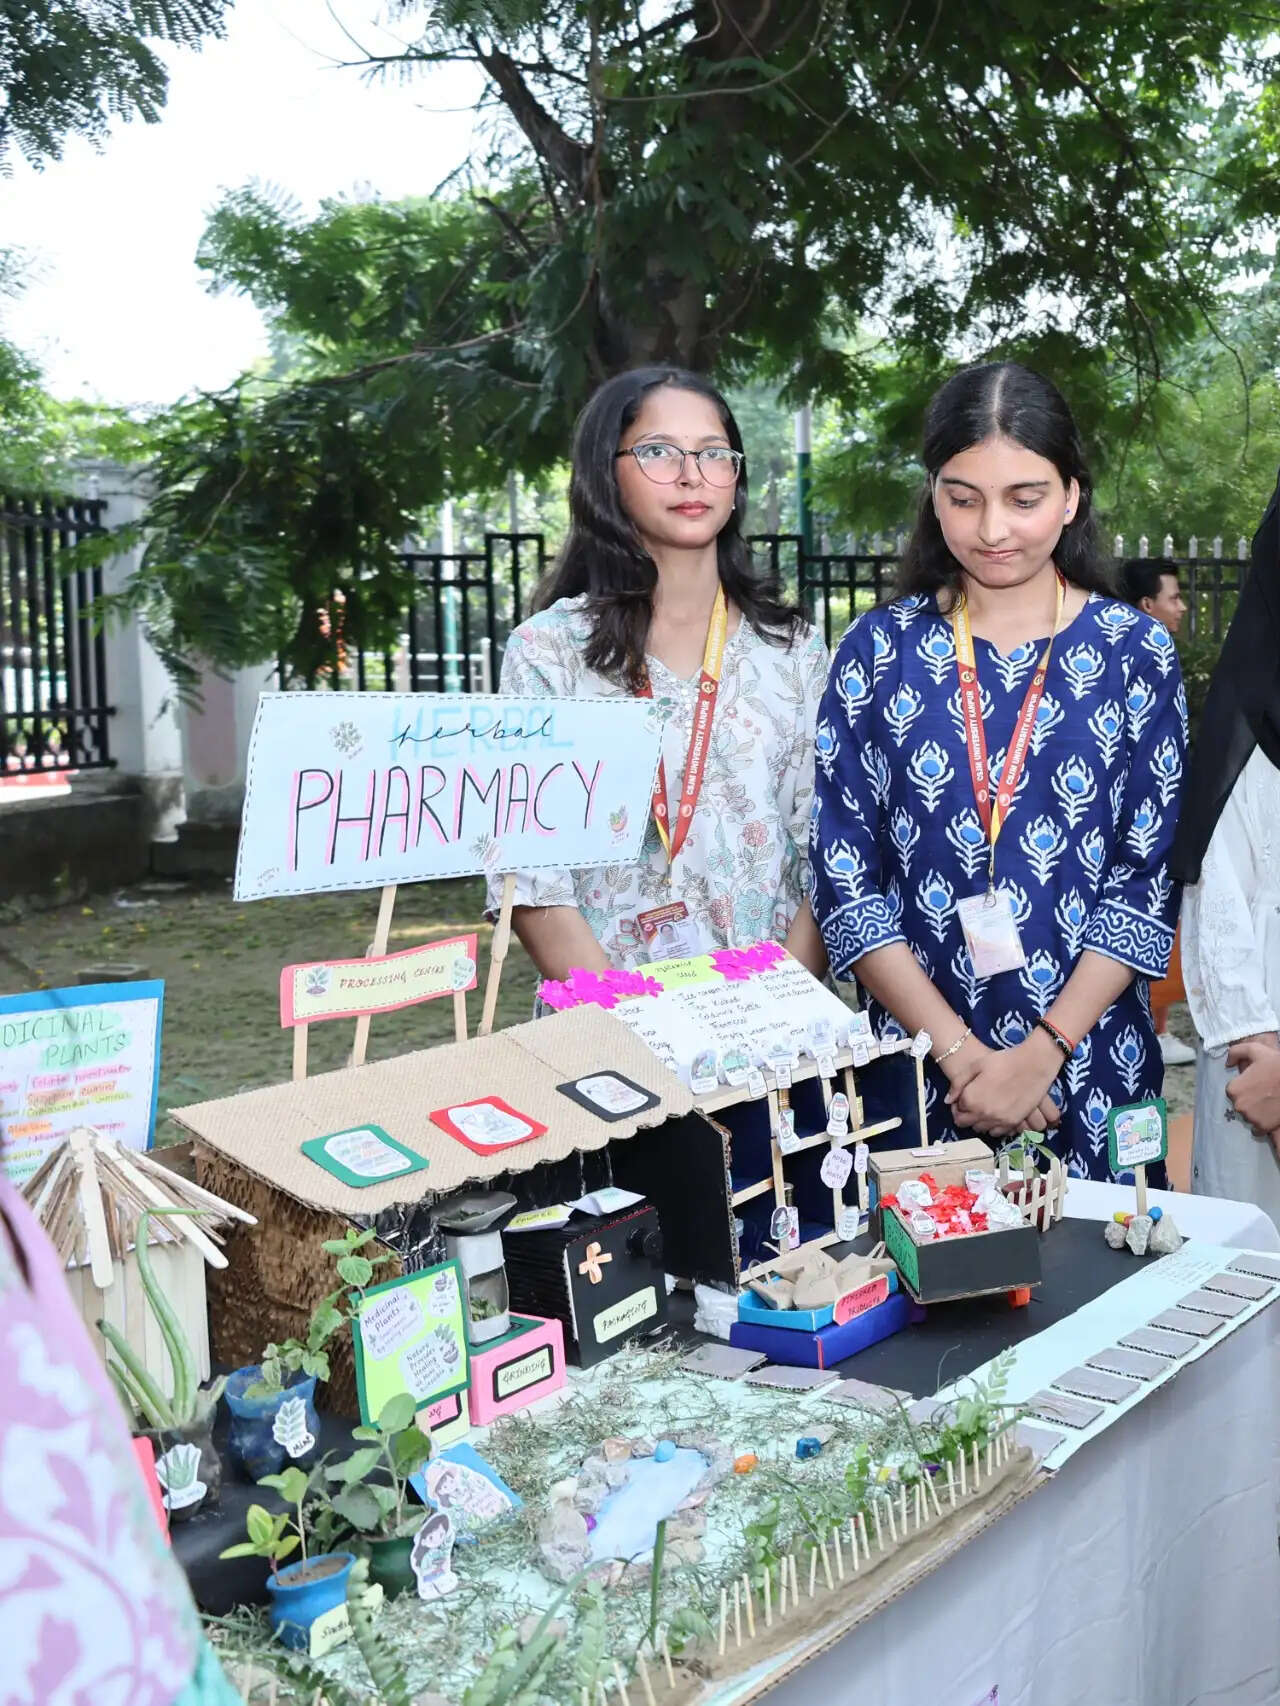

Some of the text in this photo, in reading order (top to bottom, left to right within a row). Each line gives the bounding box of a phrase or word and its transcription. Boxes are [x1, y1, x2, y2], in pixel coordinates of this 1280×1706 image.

[686, 700, 710, 796] CSJM UNIVERSITY KANPUR
[965, 690, 984, 782] CSJM UNIVERSITY KANPUR
[1006, 693, 1039, 785] CSJM UNIVERSITY KANPUR
[287, 759, 606, 872] PHARMACY
[339, 970, 407, 989] PROCESSING
[45, 1032, 127, 1067] PLANTS
[364, 1295, 401, 1328] Medicinal
[502, 1358, 547, 1385] GRINDING
